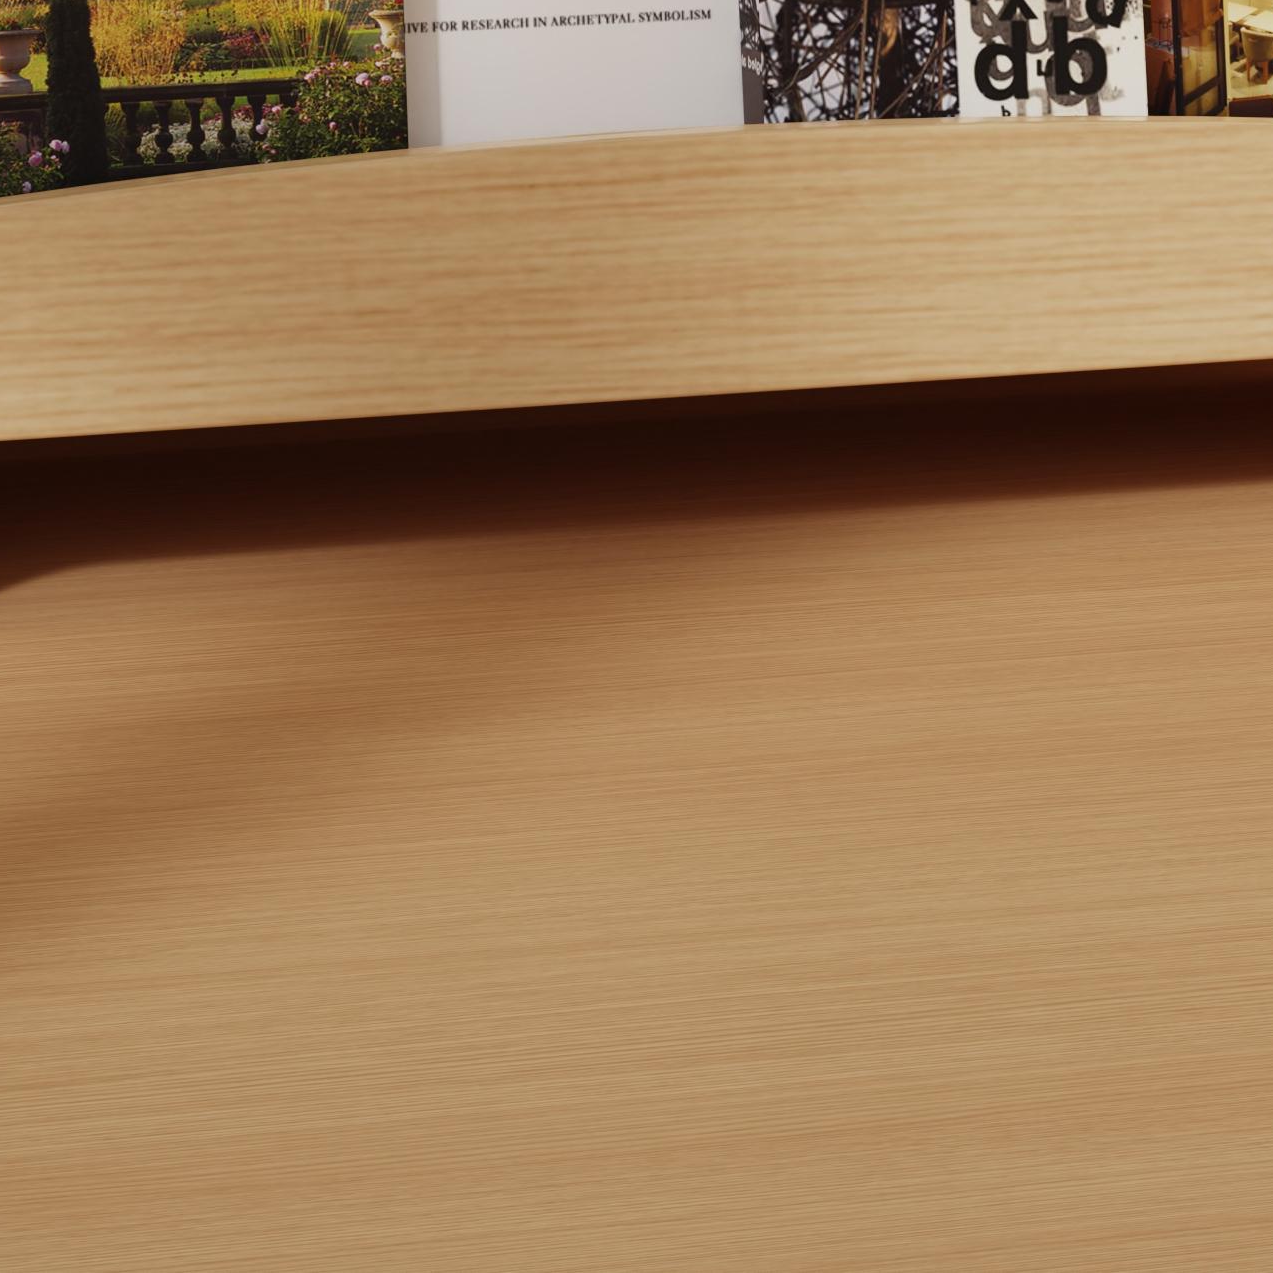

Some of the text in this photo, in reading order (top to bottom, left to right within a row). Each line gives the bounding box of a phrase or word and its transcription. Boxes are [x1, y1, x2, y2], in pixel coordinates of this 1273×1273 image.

[432, 20, 458, 33] FOR
[461, 17, 530, 31] RESEARCH
[533, 16, 548, 29] IN
[550, 12, 636, 28] ARCHETYPAL
[638, 9, 712, 24] SYMBOLISM
